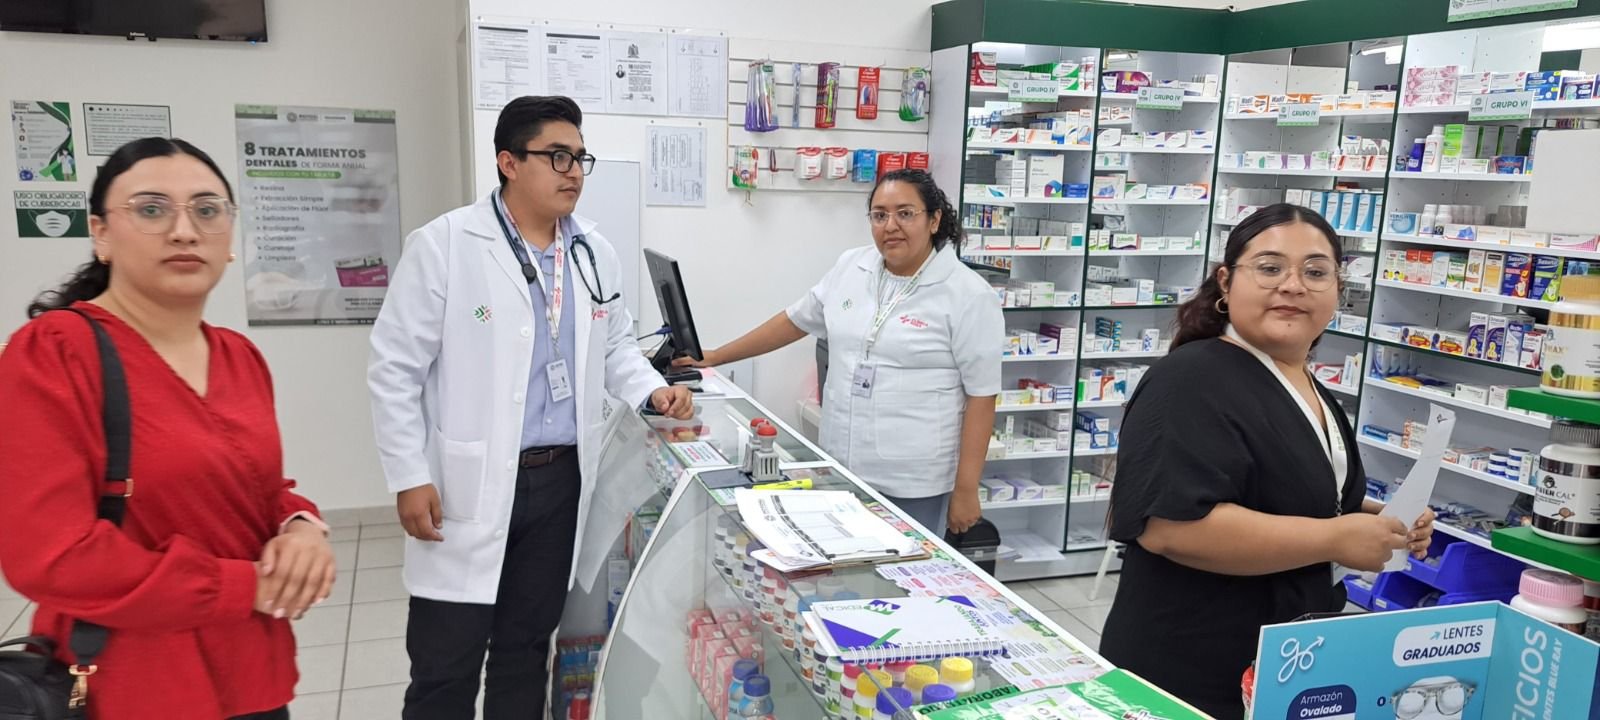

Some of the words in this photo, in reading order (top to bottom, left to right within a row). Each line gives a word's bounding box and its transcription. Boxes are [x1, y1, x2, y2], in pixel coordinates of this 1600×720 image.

[1491, 101, 1519, 109] GRUPO
[244, 142, 256, 156] 8
[258, 146, 367, 159] TRATAMIENTOS
[245, 159, 298, 168] DENTALES
[34, 192, 85, 200] OBLIGATORIO
[31, 200, 81, 208] CUBREBOCAS
[1443, 624, 1484, 641] LENTES
[1402, 642, 1481, 662] GRADUADOS
[1551, 637, 1563, 663] RAY
[1547, 660, 1560, 690] BLUE
[1300, 690, 1343, 705] Armazón
[1300, 704, 1343, 718] Ovalado
